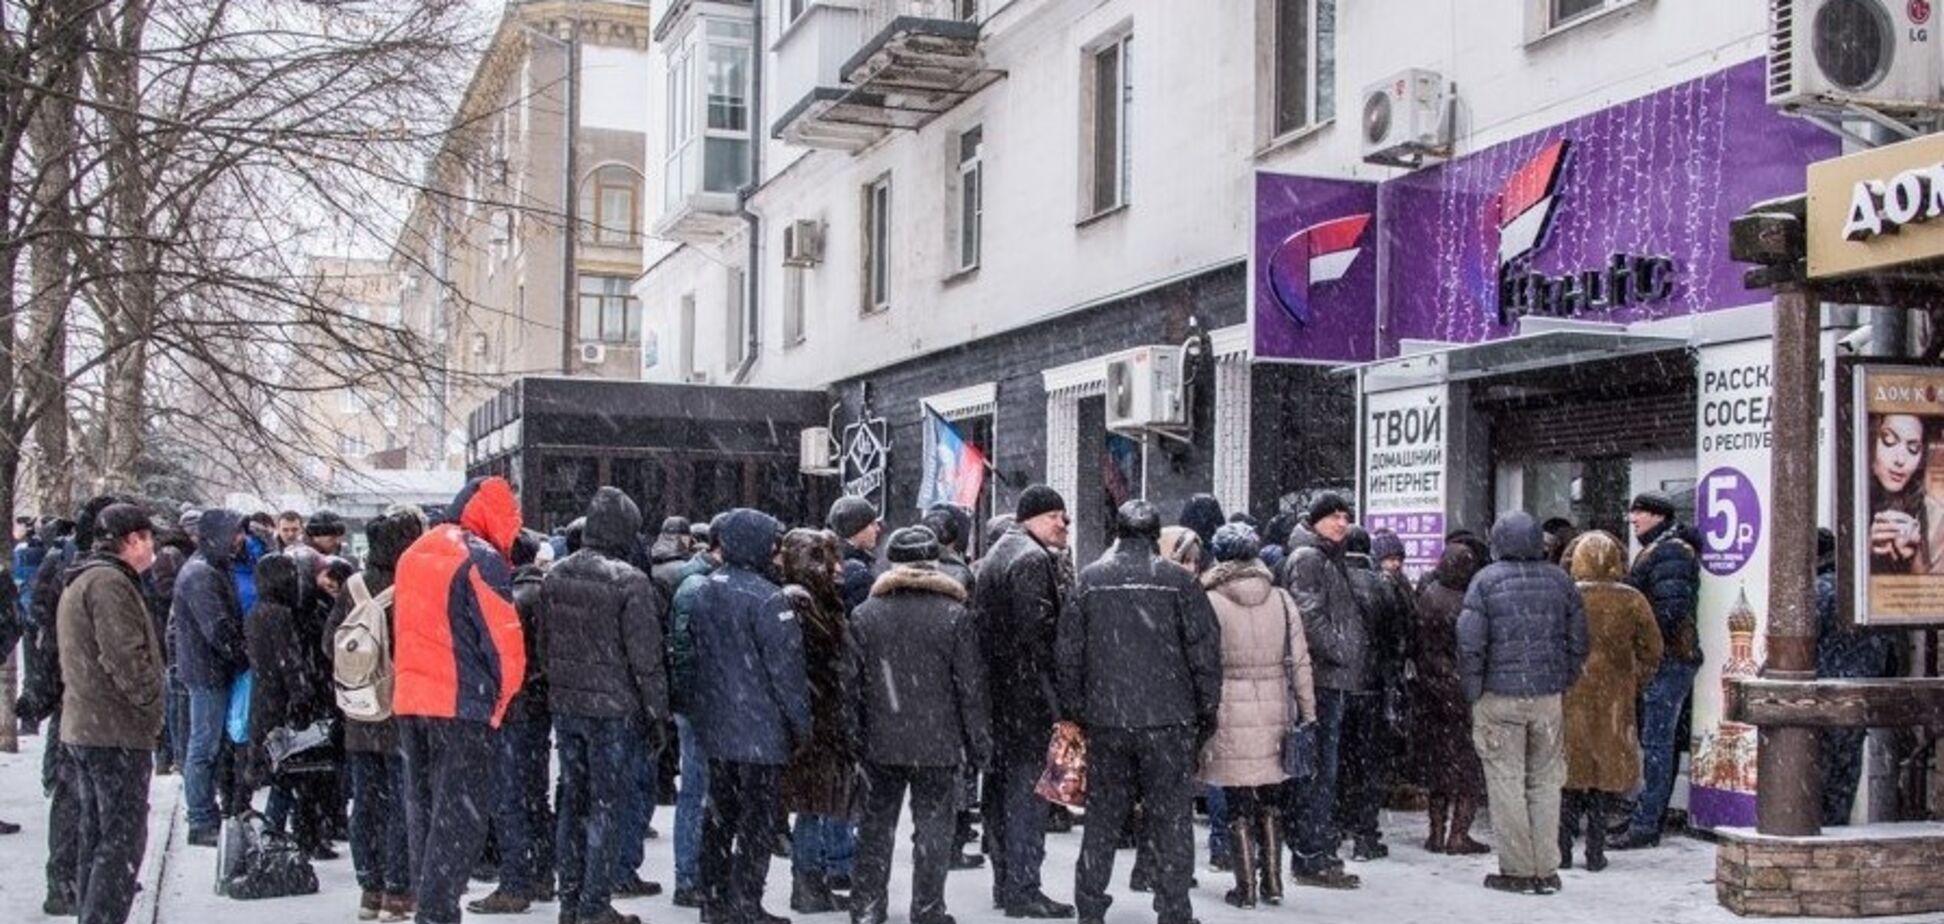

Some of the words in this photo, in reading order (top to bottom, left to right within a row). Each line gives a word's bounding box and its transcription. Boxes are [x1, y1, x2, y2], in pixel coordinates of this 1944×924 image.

[1909, 28, 1928, 42] LG
[1704, 364, 1773, 393] РАССК
[1372, 396, 1441, 447] ТВОЙ
[1702, 435, 1712, 452] О
[1370, 444, 1441, 471] ДОМАШНИЙ
[1370, 471, 1440, 493] ИНТЕРНЕТ
